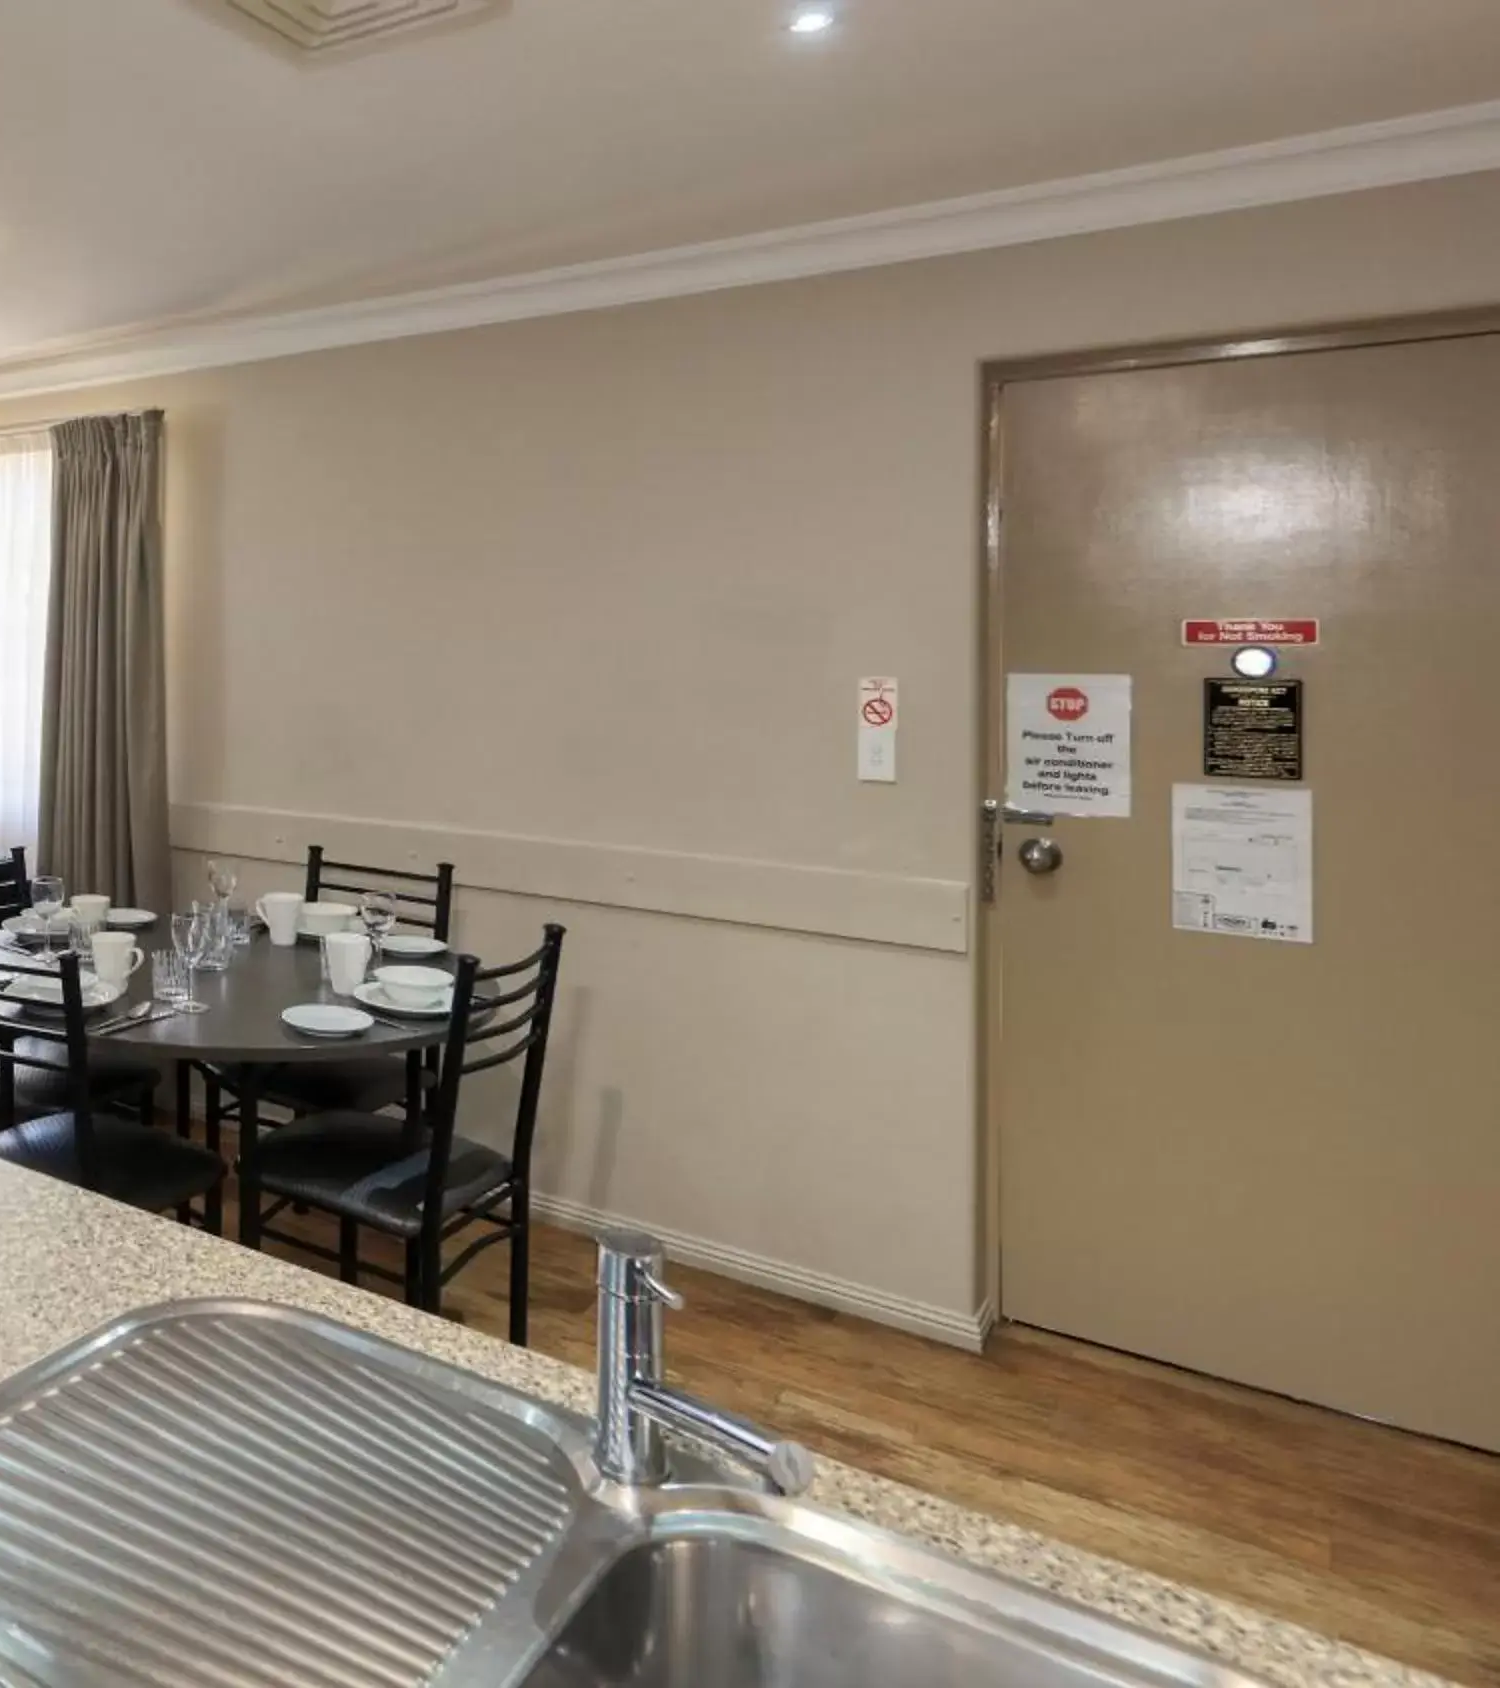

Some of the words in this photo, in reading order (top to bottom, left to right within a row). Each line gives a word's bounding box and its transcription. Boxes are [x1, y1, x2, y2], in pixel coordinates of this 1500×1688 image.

[1218, 622, 1256, 631] Thank
[1260, 622, 1284, 631] You
[1197, 631, 1215, 641] for
[1218, 631, 1242, 641] Not
[1245, 631, 1304, 643] Smoking
[1050, 697, 1085, 711] STOP
[1022, 730, 1062, 741] Please
[1057, 744, 1077, 754] the
[1044, 759, 1113, 769] conditioner
[1038, 769, 1060, 779] and
[1063, 770, 1097, 782] lights
[1065, 782, 1109, 796] leaving
